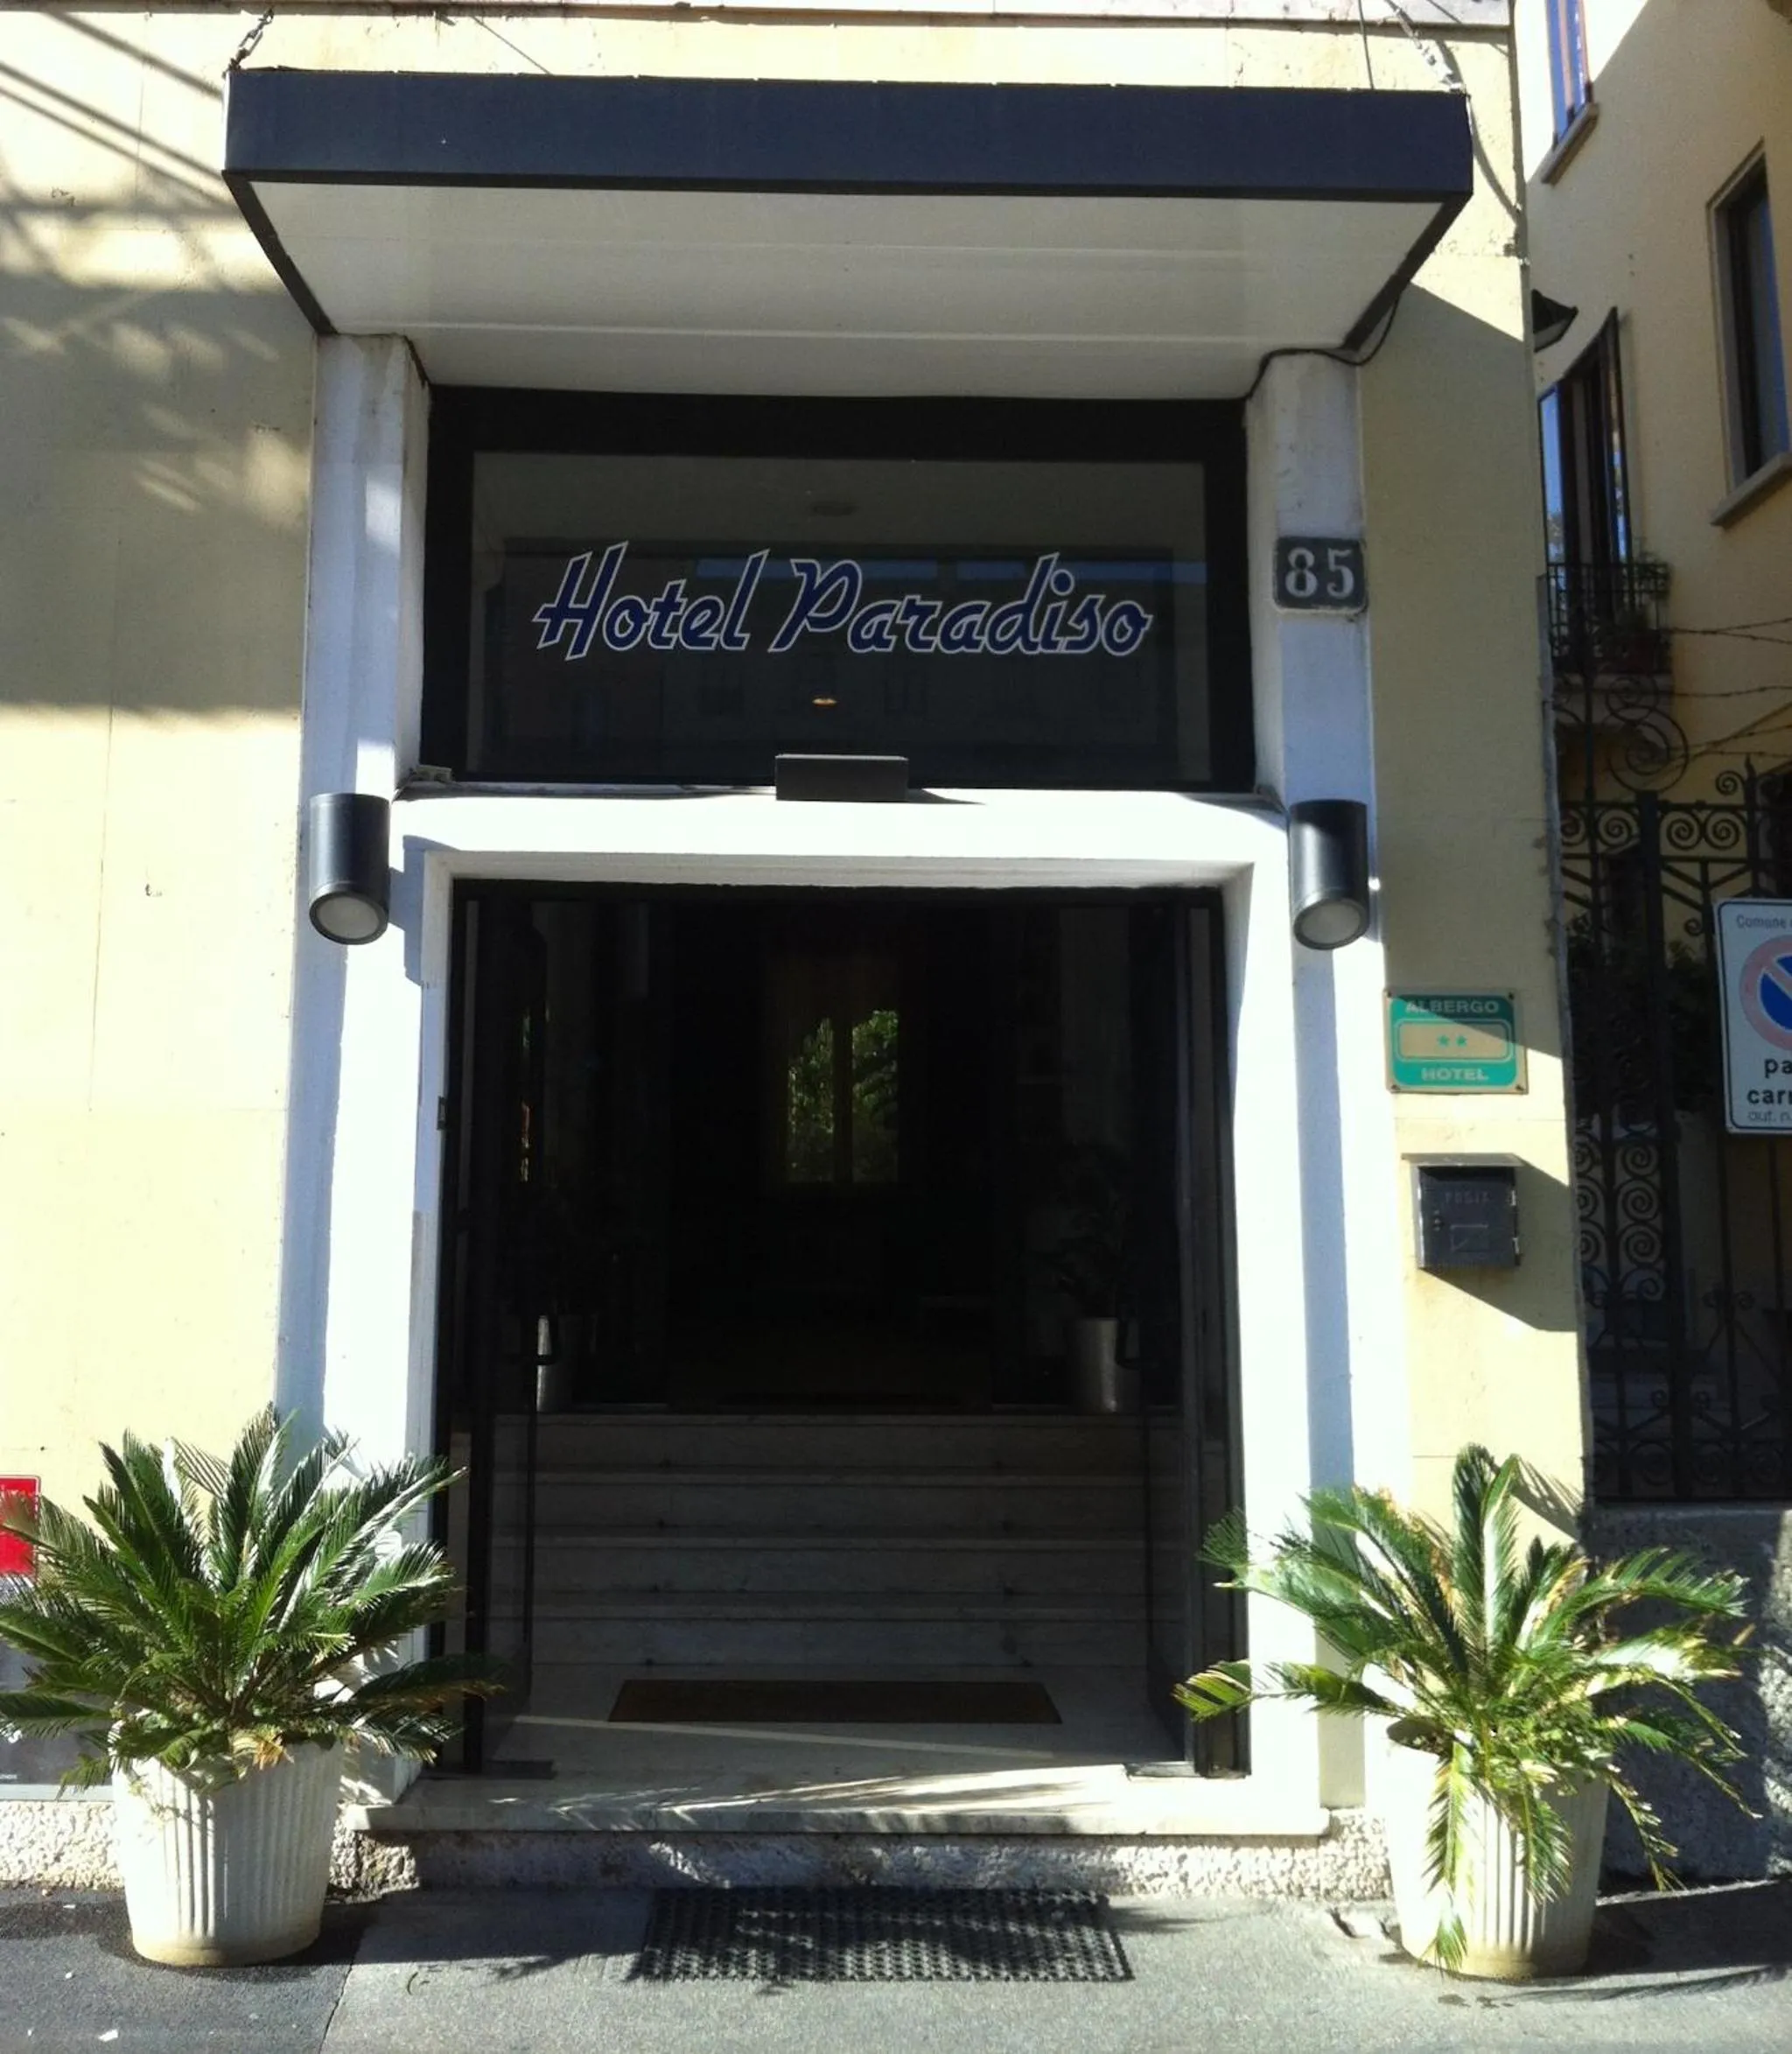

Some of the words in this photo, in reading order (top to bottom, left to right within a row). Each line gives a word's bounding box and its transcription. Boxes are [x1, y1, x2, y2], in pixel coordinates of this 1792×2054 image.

[1284, 547, 1355, 599] 85
[532, 541, 770, 660] Hotel
[768, 553, 1153, 656] Paradiso
[1736, 914, 1787, 929] Comune
[1405, 1000, 1500, 1013] ALBERGO
[1421, 1067, 1488, 1081] HOTEL
